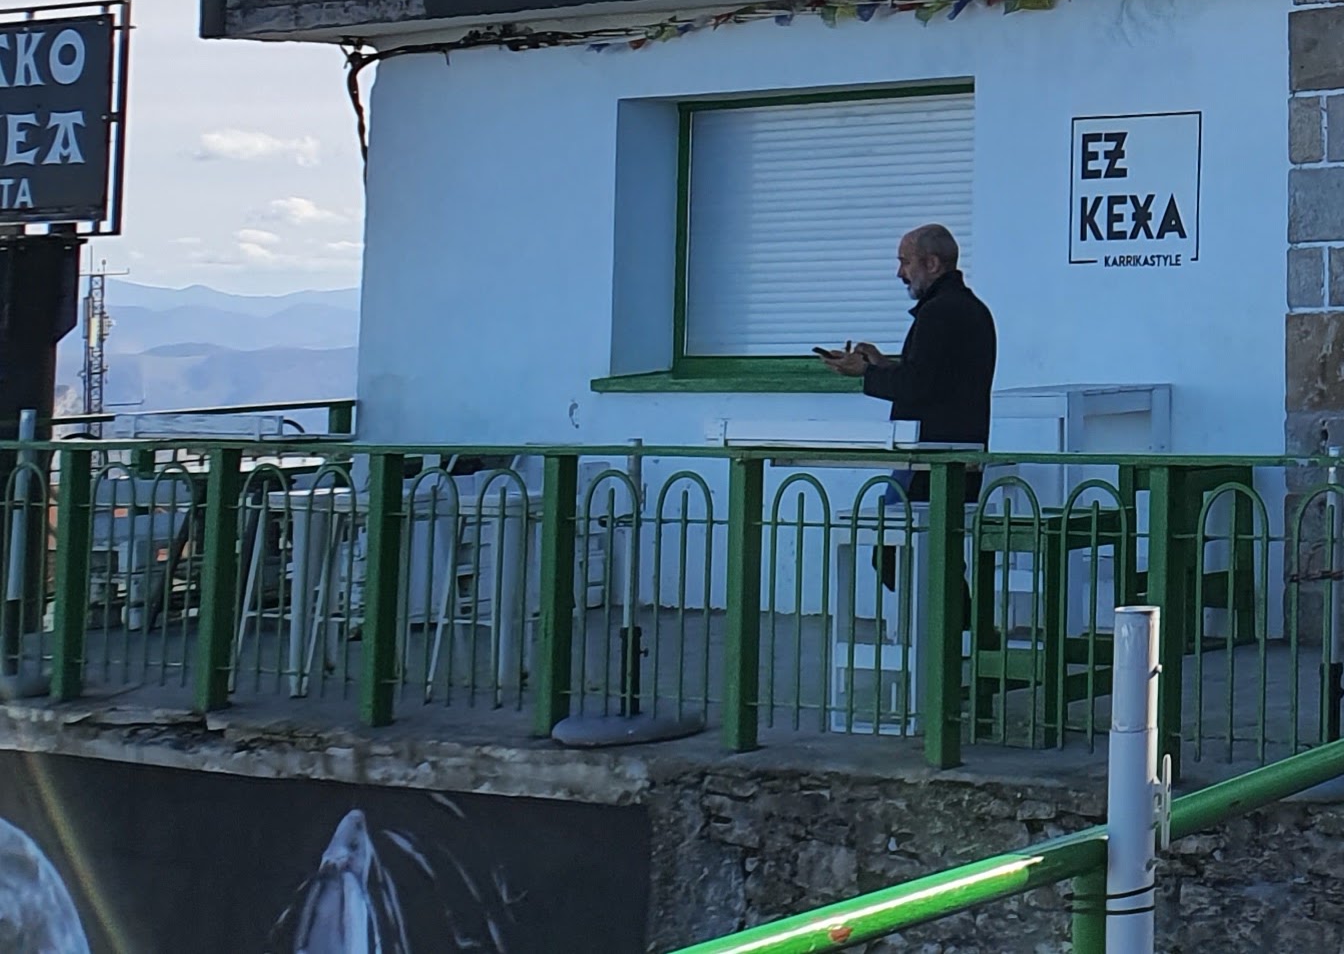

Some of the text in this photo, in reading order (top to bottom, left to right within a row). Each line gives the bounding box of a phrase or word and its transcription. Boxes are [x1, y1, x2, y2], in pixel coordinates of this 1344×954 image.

[0, 29, 86, 87] KO
[0, 110, 86, 166] EA
[1081, 132, 1128, 180] EZ
[0, 178, 35, 209] TA
[1080, 193, 1187, 241] KEXA
[1104, 254, 1182, 267] KARRIKASTYLE
